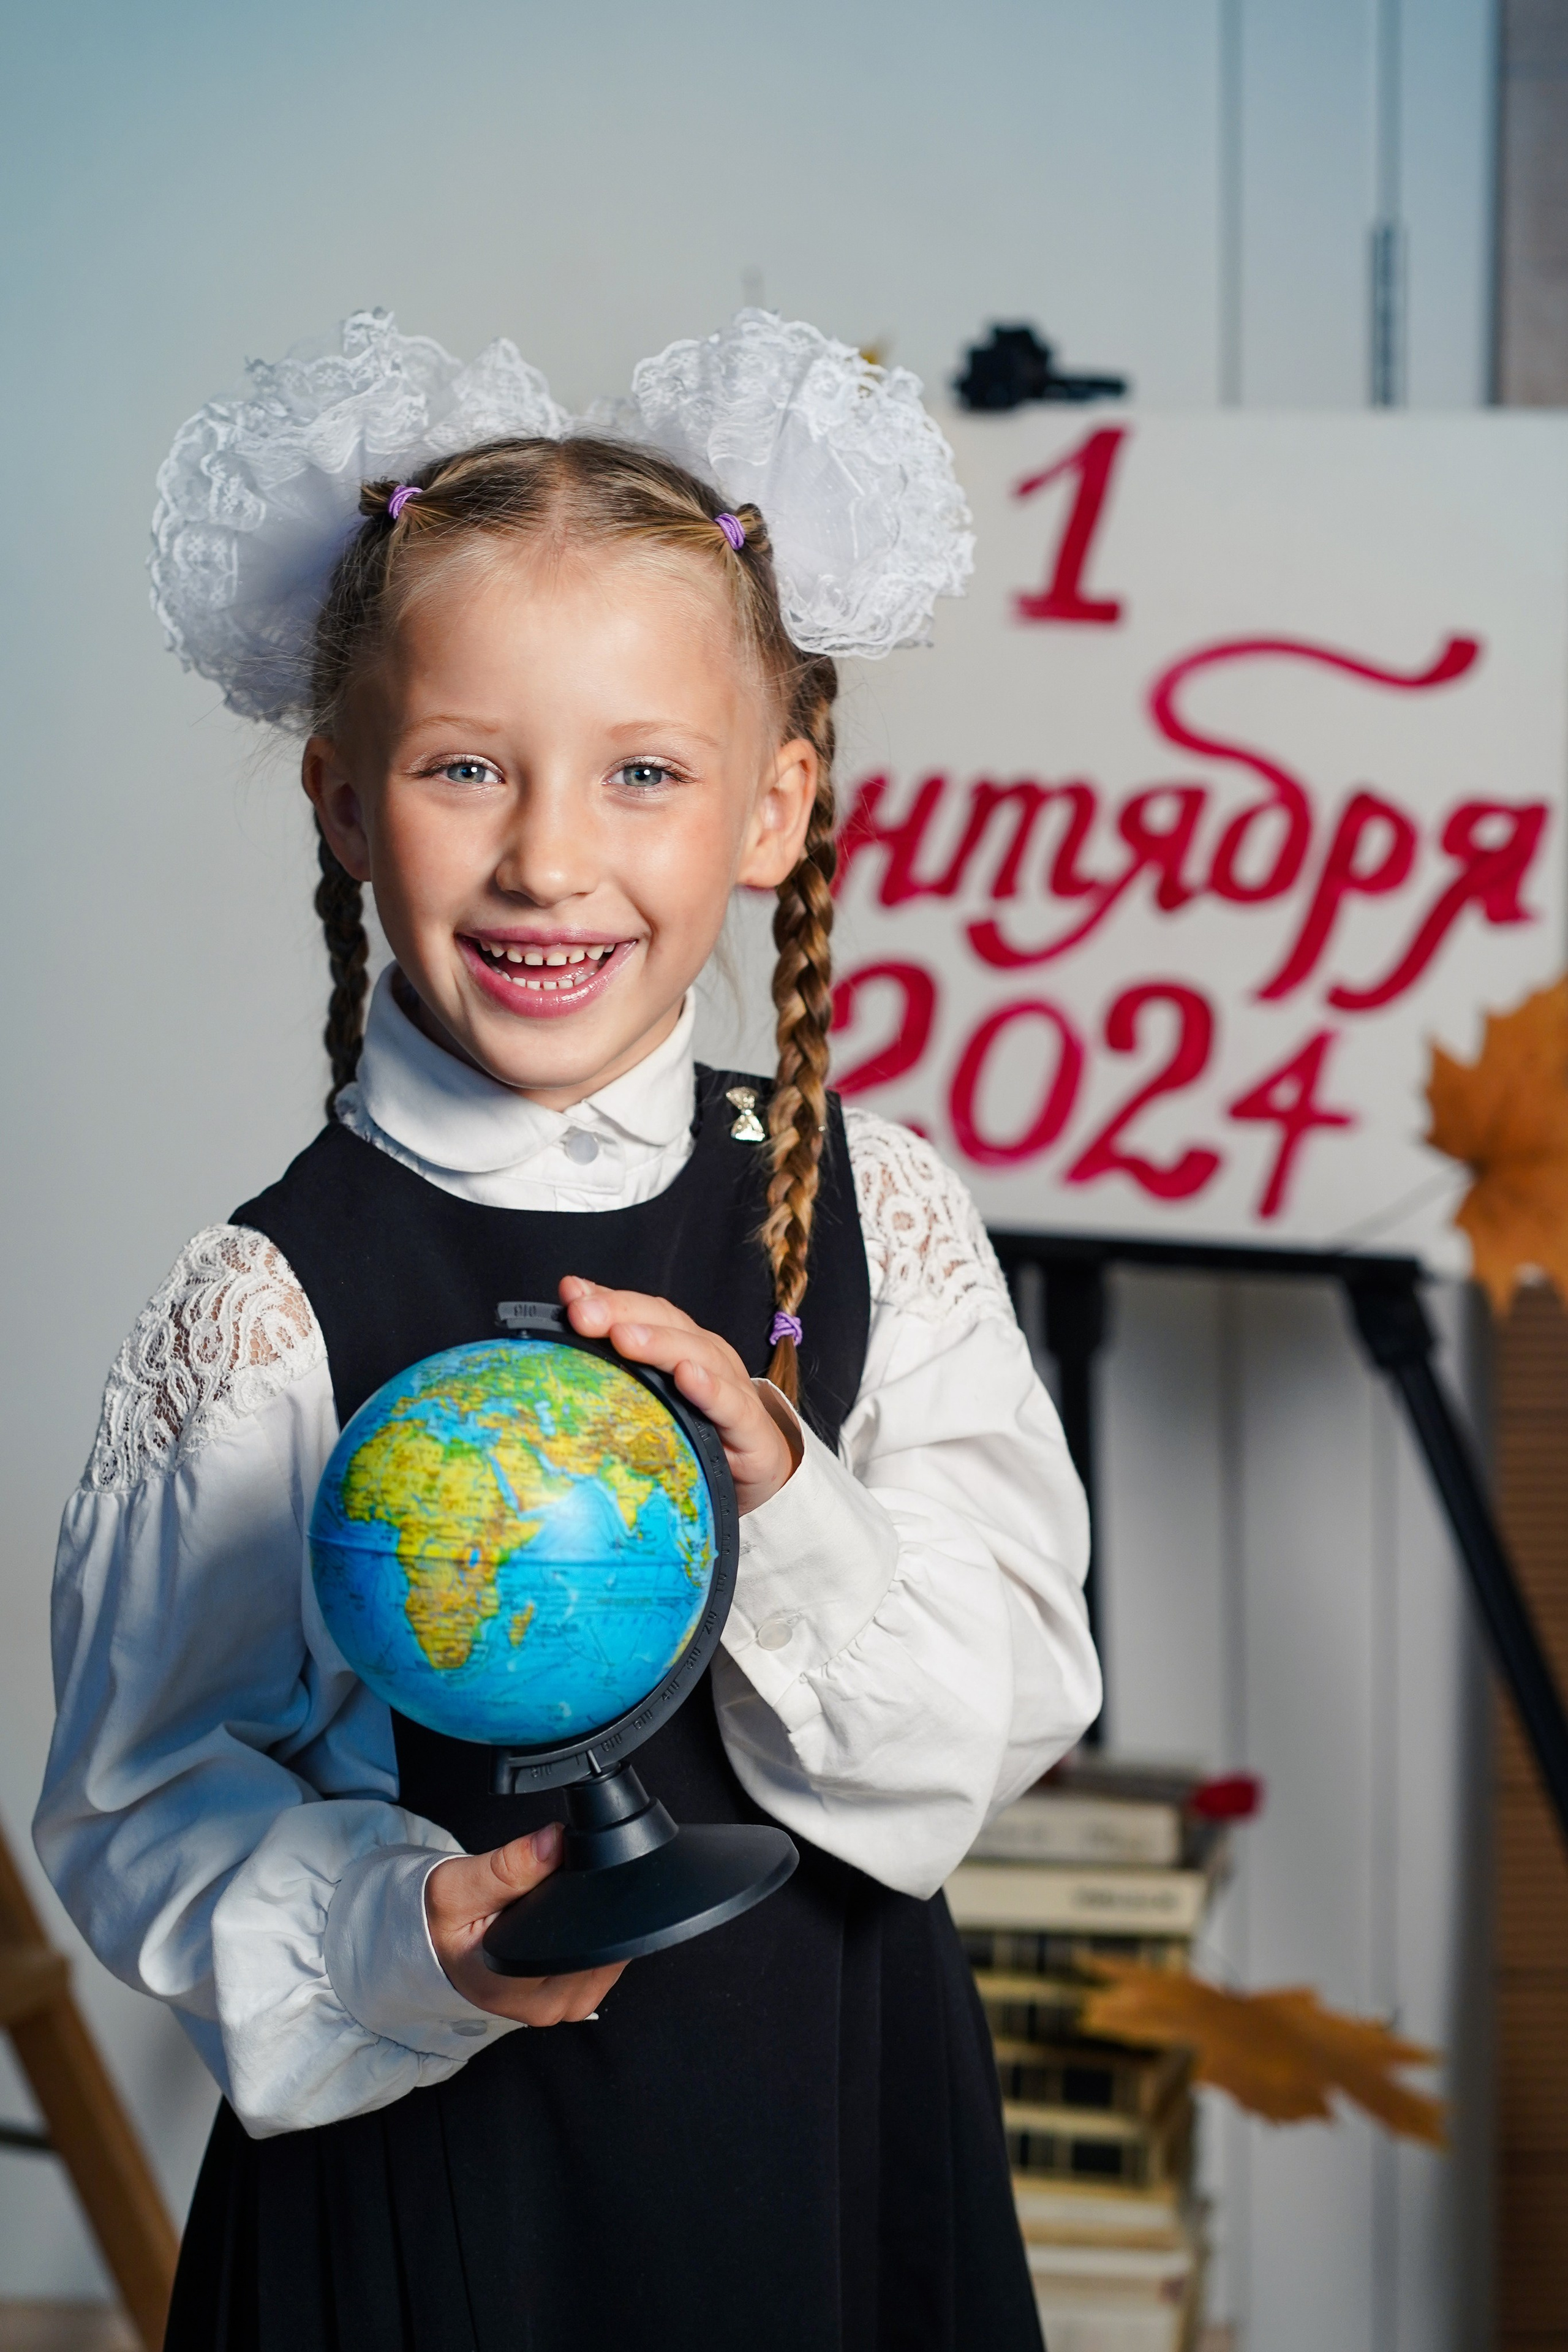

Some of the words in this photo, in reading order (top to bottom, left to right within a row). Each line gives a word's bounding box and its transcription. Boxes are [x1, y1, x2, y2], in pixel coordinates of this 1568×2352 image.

[1013, 423, 1130, 627] 1
[829, 633, 1548, 1011] нтября
[827, 958, 1357, 1221] 2024
